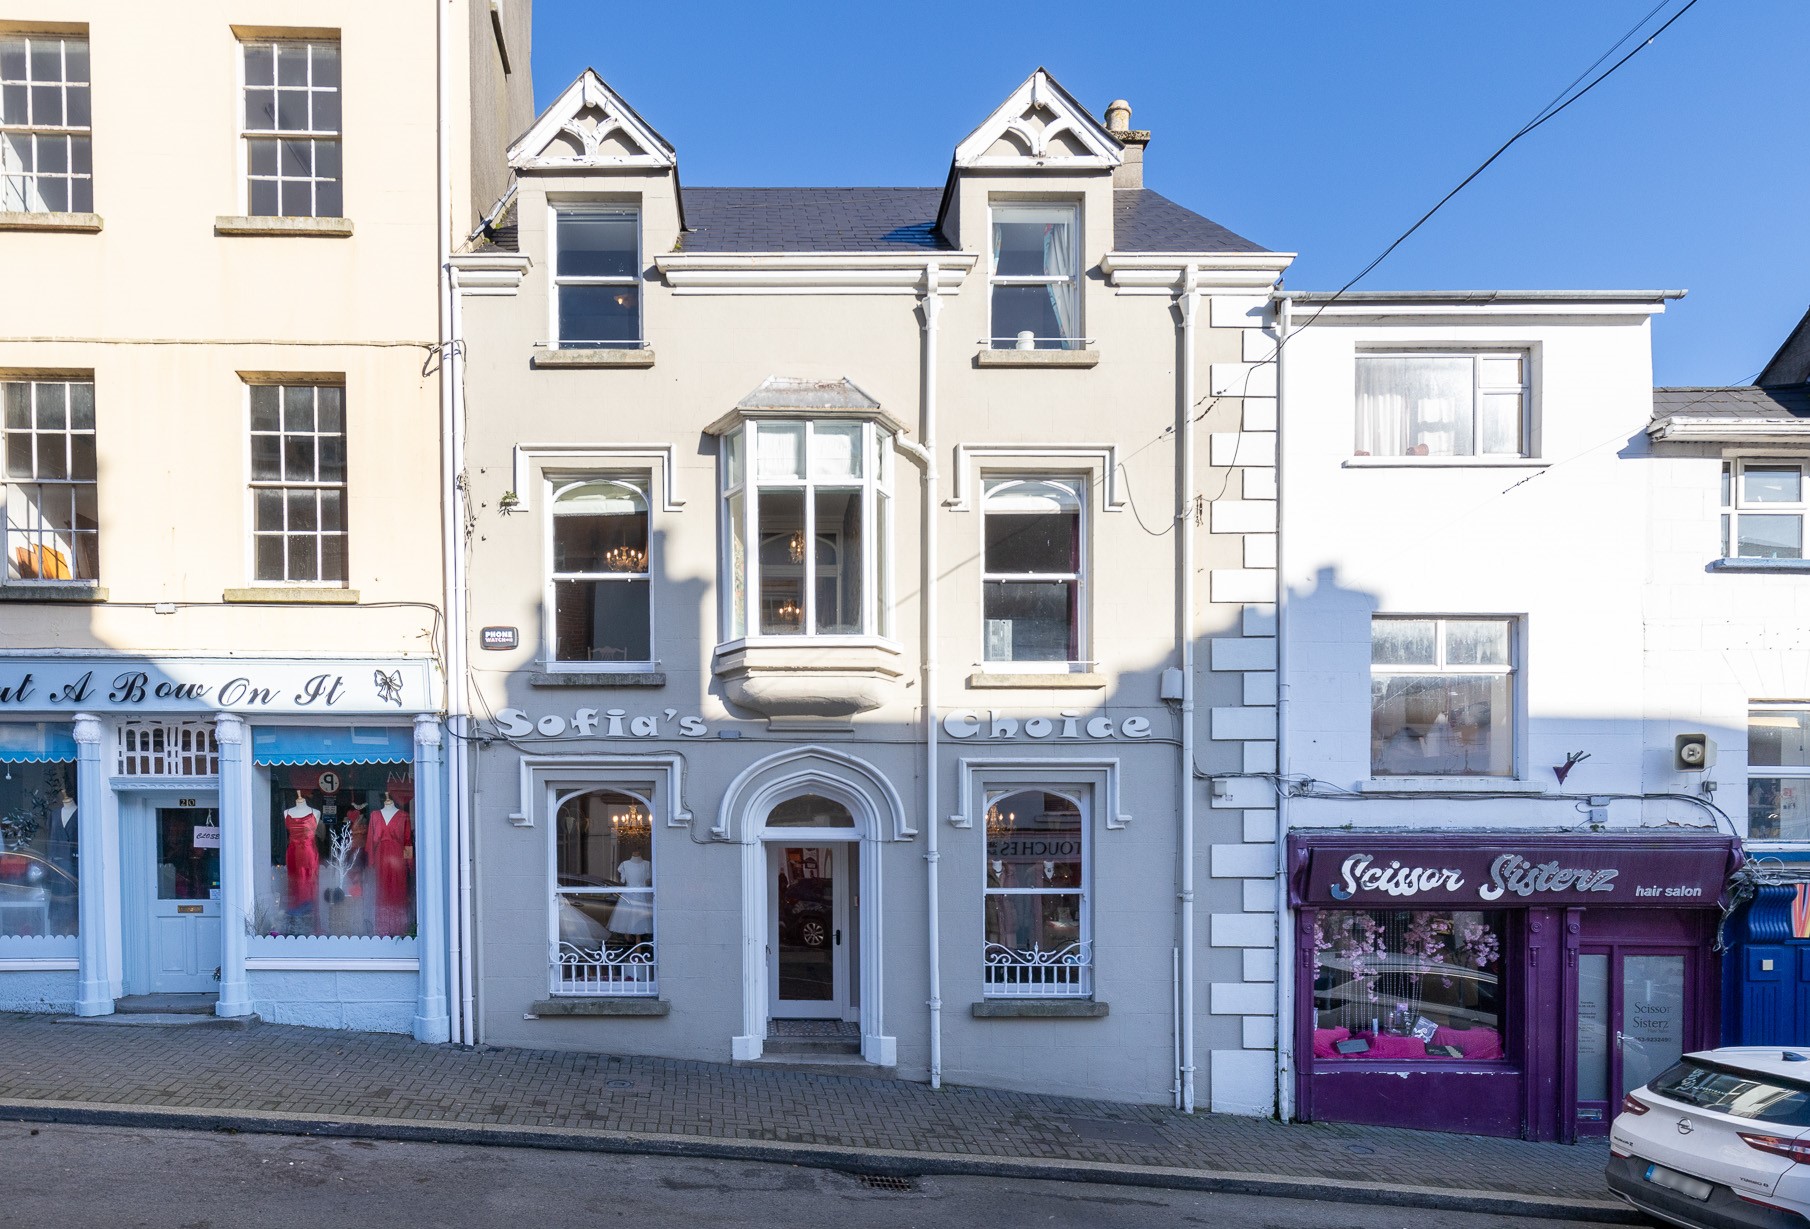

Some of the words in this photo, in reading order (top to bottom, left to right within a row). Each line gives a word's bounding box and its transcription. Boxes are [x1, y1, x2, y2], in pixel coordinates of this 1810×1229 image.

[50, 671, 96, 703] A
[109, 671, 212, 703] Bow
[218, 677, 280, 706] On
[294, 674, 345, 706] It
[495, 708, 708, 737] Sofia's
[943, 709, 1152, 739] Choice
[1331, 853, 1465, 900] Scissor
[1479, 853, 1619, 901] Sisterz
[1636, 885, 1663, 896] hair
[1665, 885, 1702, 896] salon
[1634, 1002, 1671, 1013] Scissor
[1632, 1017, 1669, 1029] Sisterz
